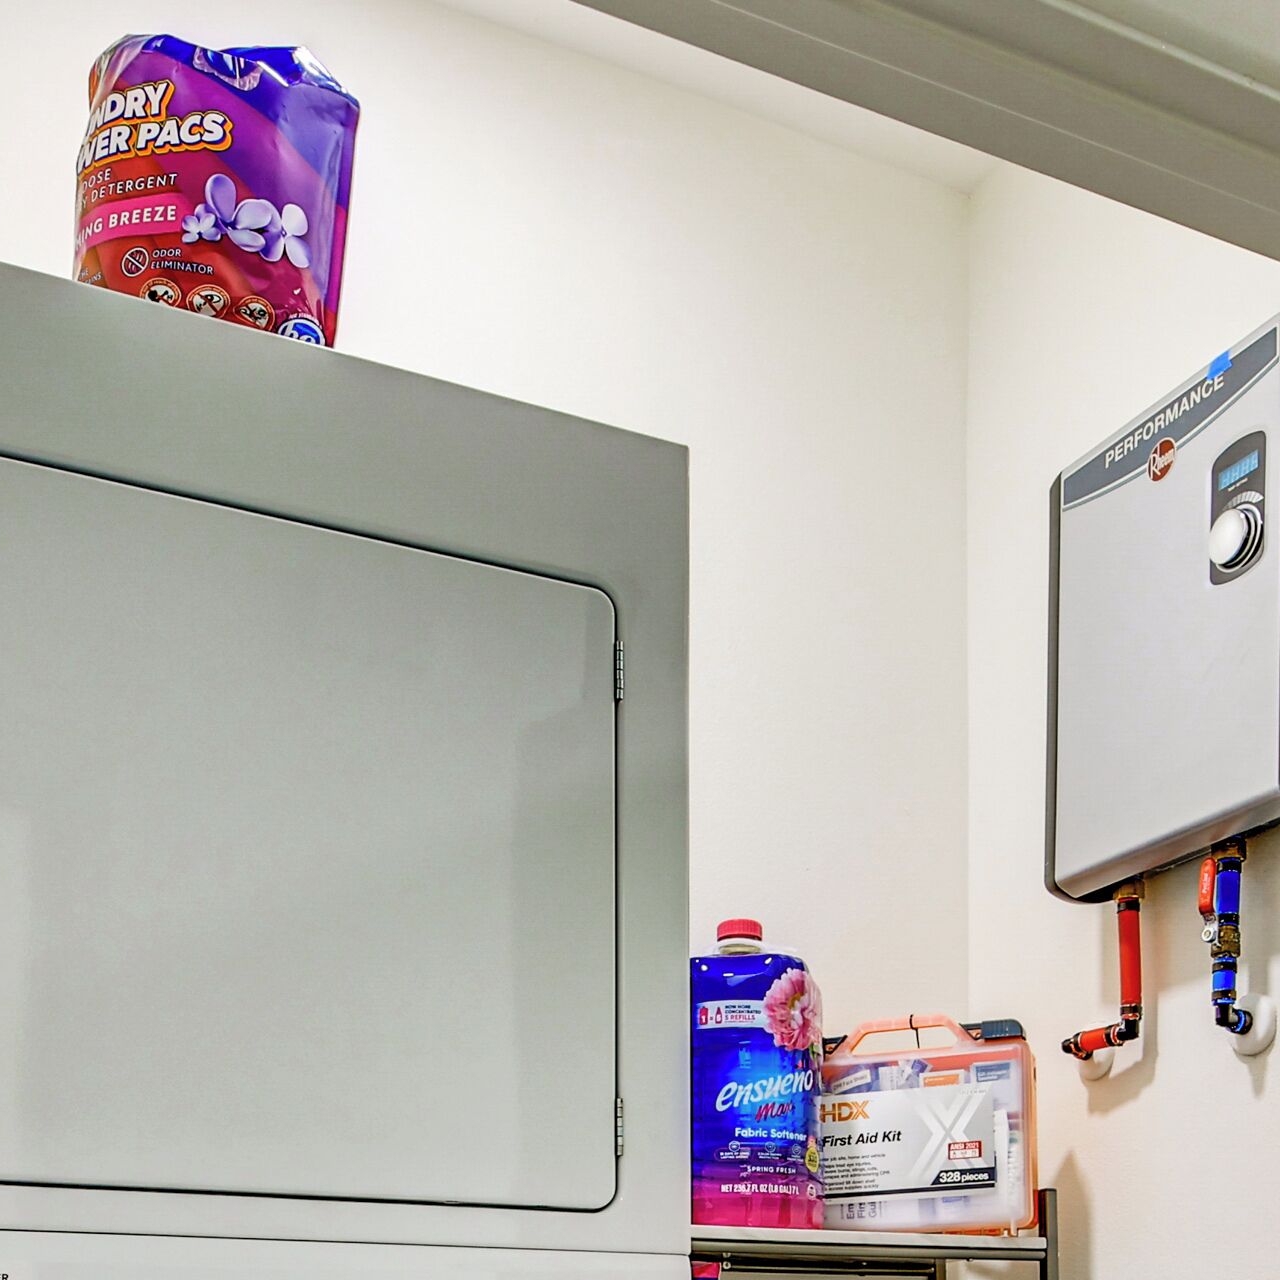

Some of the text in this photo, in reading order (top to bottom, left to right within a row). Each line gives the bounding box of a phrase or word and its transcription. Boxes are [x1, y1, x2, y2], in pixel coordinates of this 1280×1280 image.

[136, 113, 226, 149] PACS
[91, 173, 178, 202] DETERGENT
[108, 205, 177, 228] BREEZE
[152, 248, 182, 258] ODOR
[151, 259, 215, 275] ELIMINATOR
[1104, 374, 1225, 469] PERFORMANCE
[1149, 443, 1175, 478] Rheem
[820, 1100, 870, 1123] HDX
[735, 1127, 807, 1141] Fabric Softener
[822, 1130, 902, 1148] First Aid Kit
[747, 1165, 797, 1174] SPRING FRESH
[938, 1171, 989, 1183] 328 pieces
[721, 1184, 733, 1193] NET
